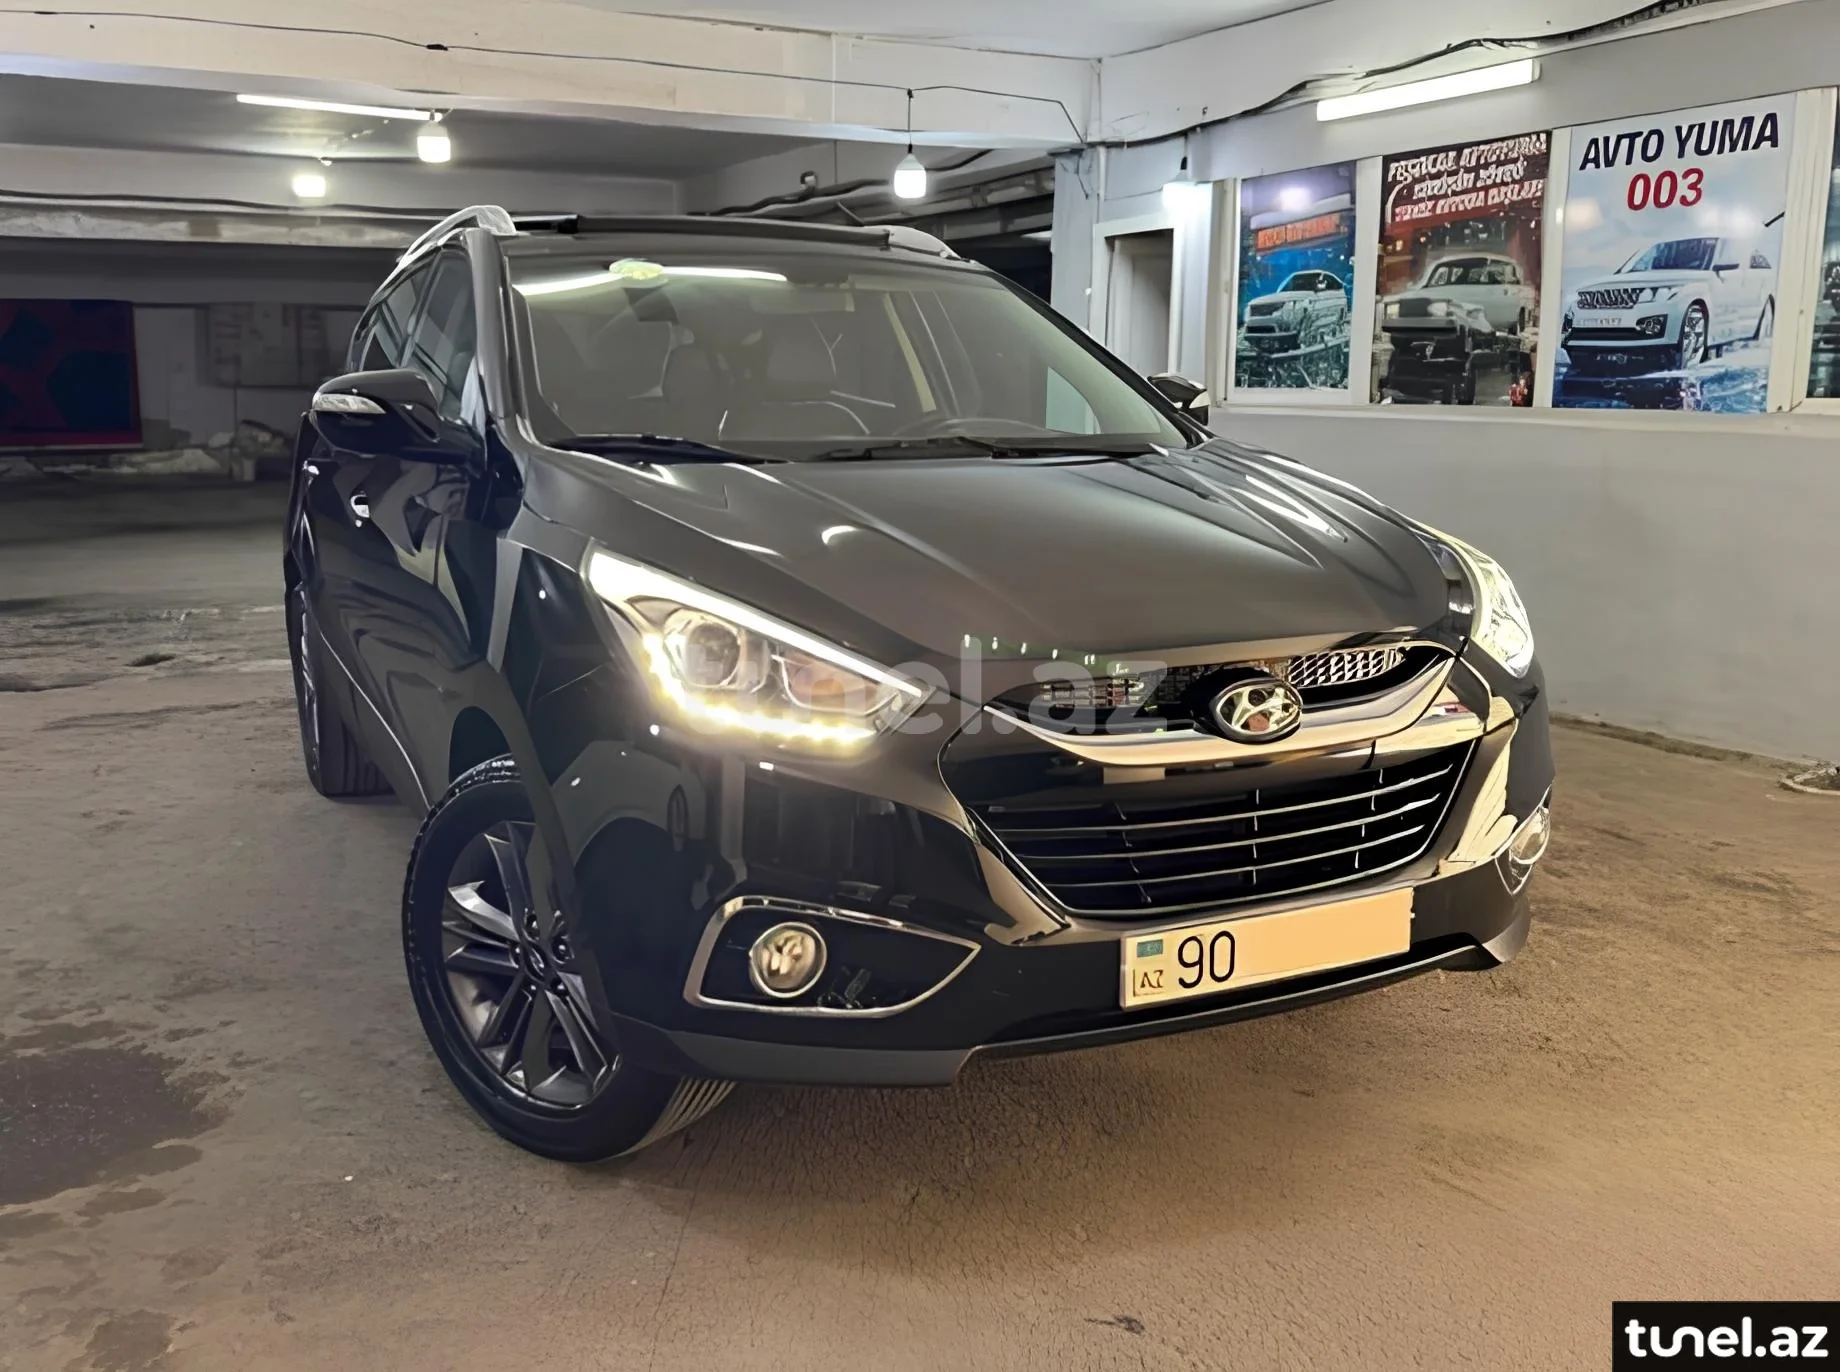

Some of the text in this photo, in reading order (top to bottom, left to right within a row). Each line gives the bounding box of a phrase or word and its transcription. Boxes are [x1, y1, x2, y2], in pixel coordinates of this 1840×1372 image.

[1579, 129, 1664, 170] AVTO
[1675, 113, 1778, 159] YUMA
[1627, 168, 1704, 211] 003
[1178, 931, 1235, 989] 90
